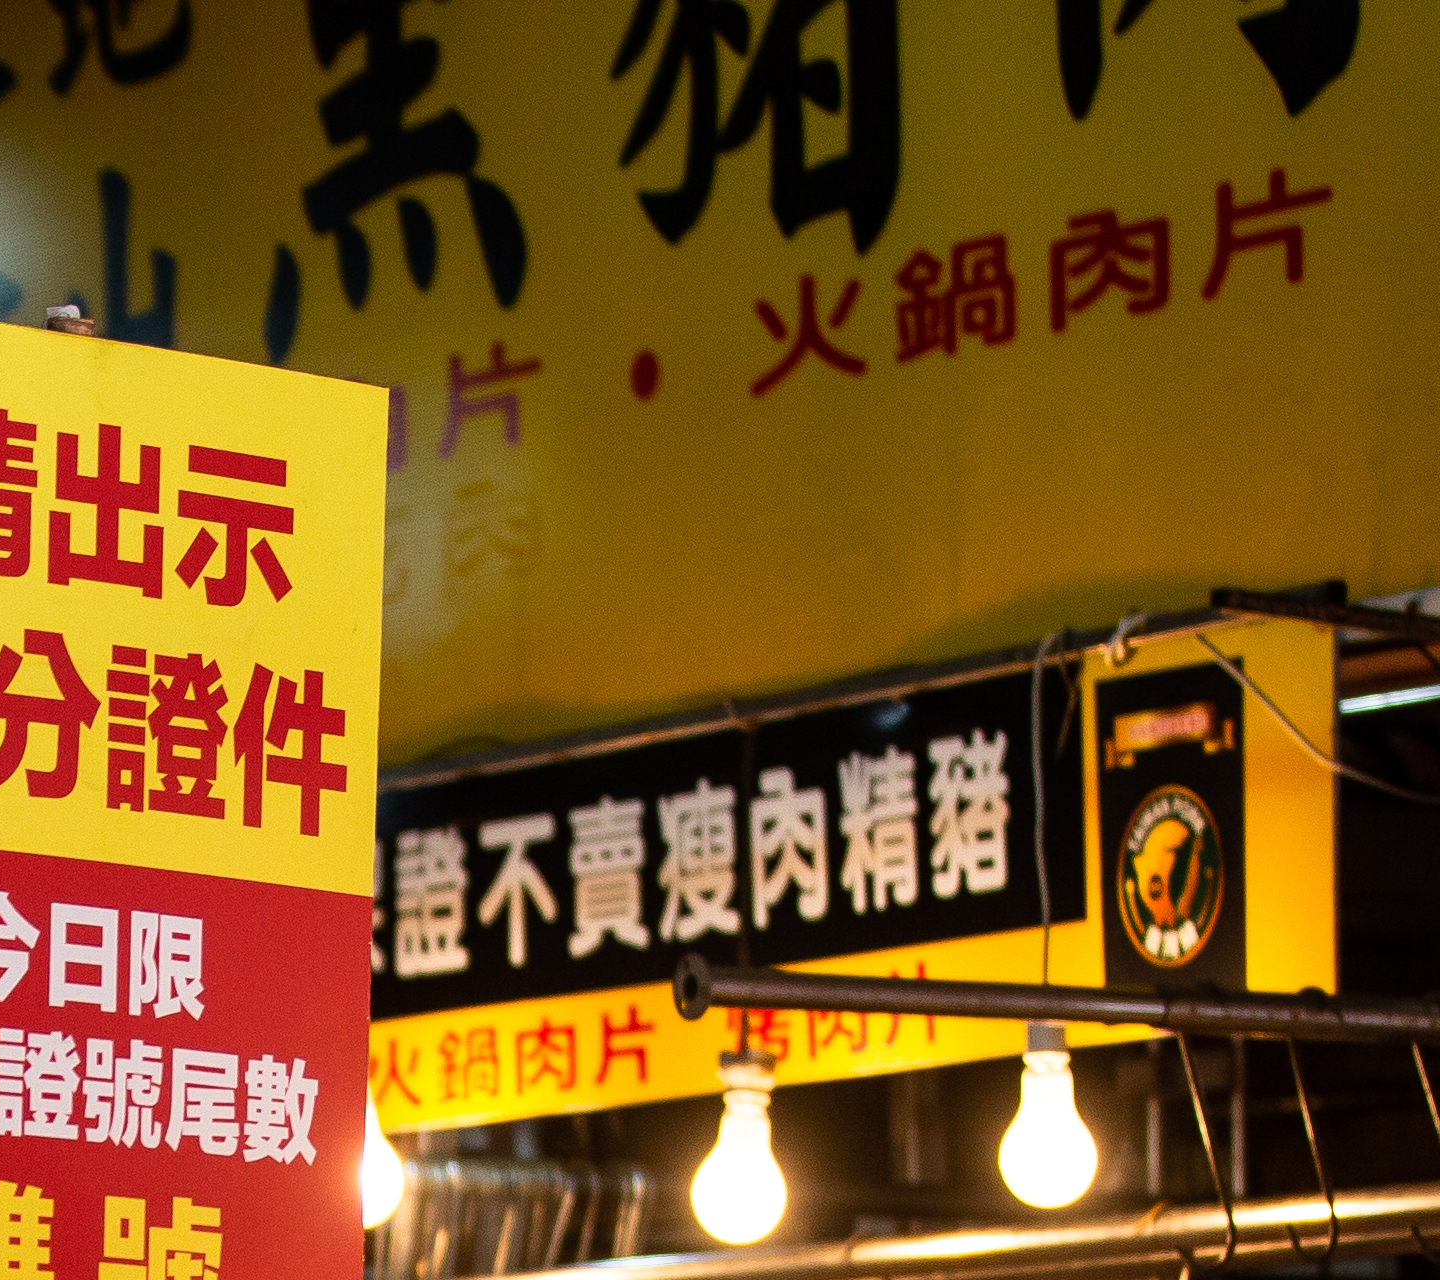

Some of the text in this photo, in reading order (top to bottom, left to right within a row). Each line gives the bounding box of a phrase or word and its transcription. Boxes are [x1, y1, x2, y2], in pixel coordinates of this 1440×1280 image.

[751, 168, 1332, 396] 火鍋肉片
[374, 728, 1012, 982] 證不賣瘦肉精豬
